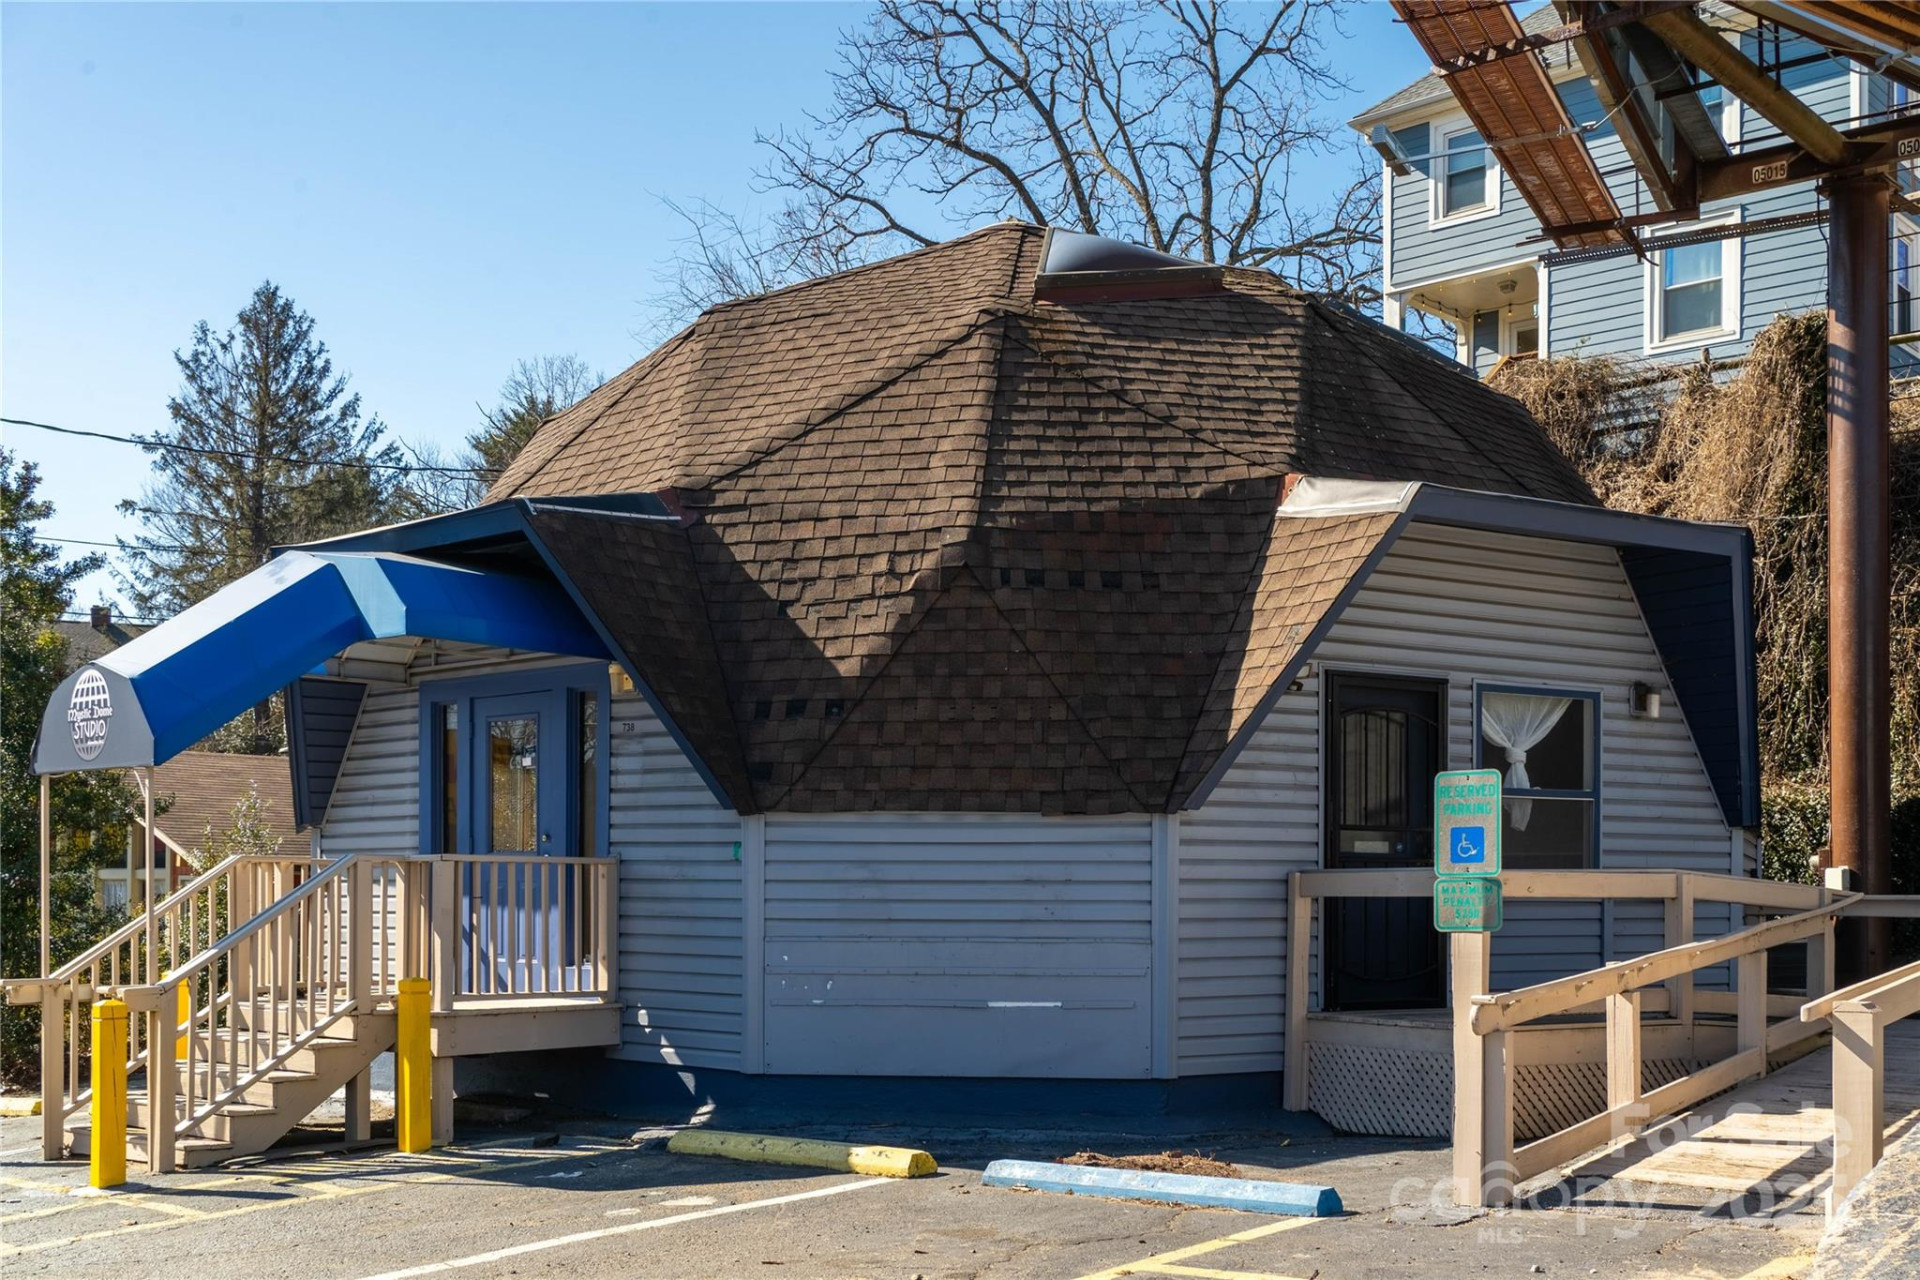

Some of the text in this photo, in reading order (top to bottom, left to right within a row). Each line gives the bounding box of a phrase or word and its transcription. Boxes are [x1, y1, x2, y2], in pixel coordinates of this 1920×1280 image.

[1753, 165, 1786, 182] 05015
[74, 720, 106, 739] STUDIO
[622, 723, 635, 732] 738
[1440, 784, 1496, 798] RESERVED
[1443, 802, 1493, 816] PARKING
[1441, 886, 1493, 895] MAXIMUM
[1443, 896, 1492, 906] PENALTY
